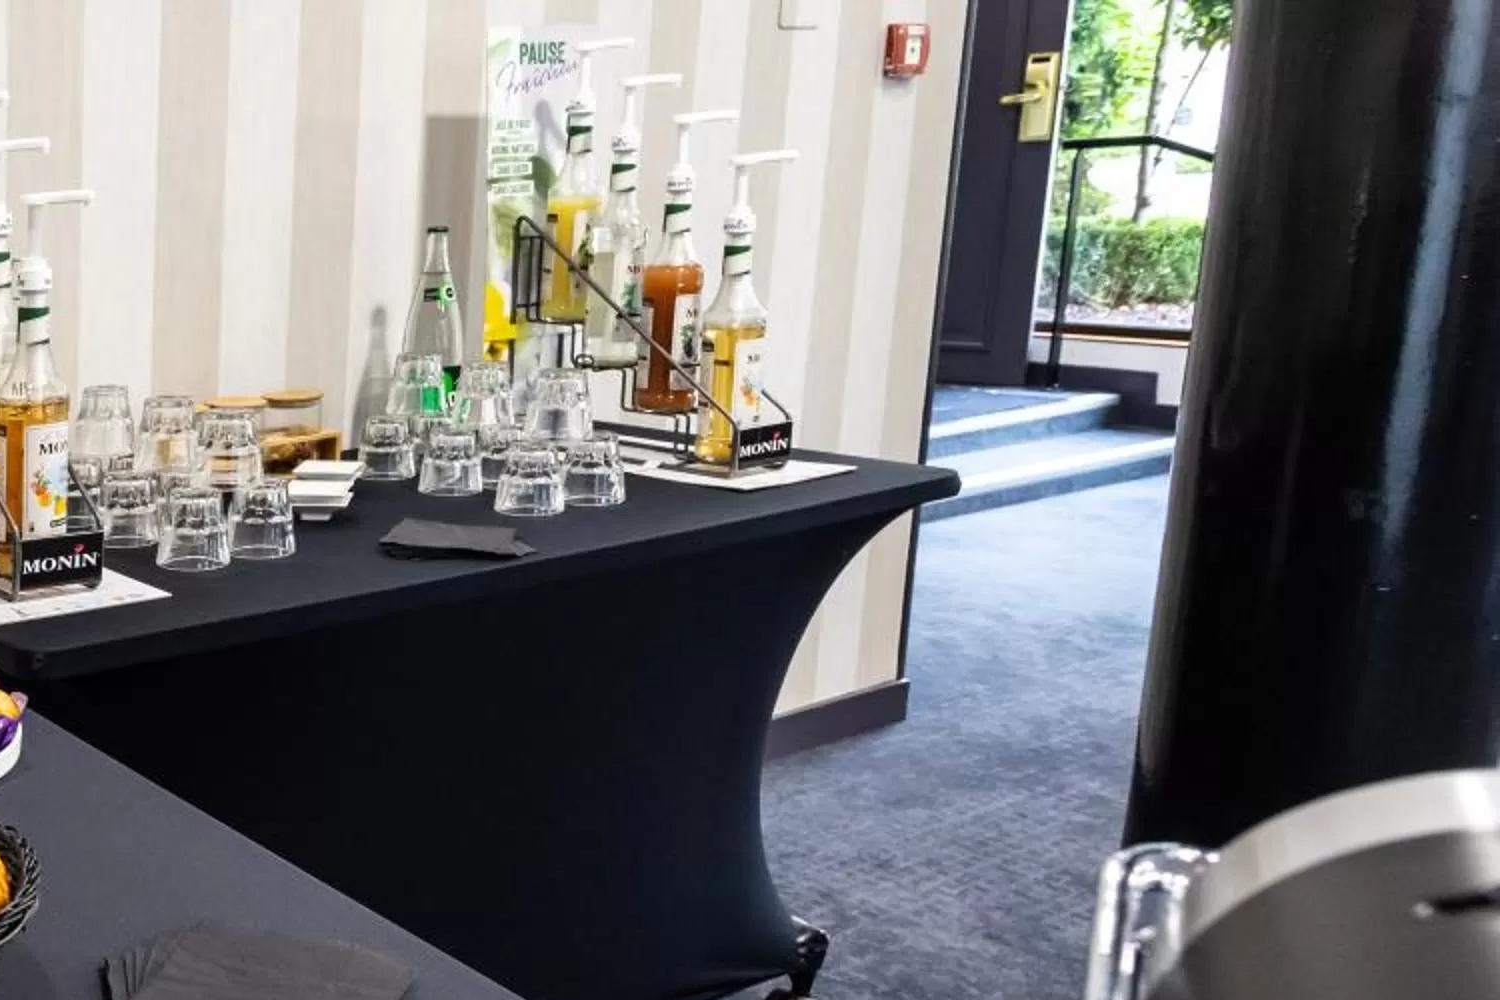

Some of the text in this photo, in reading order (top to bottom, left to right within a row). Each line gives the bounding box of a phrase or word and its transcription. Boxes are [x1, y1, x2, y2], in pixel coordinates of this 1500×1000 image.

[519, 41, 565, 65] PAUSE
[739, 436, 789, 458] MONIN
[23, 551, 98, 575] MONIN
